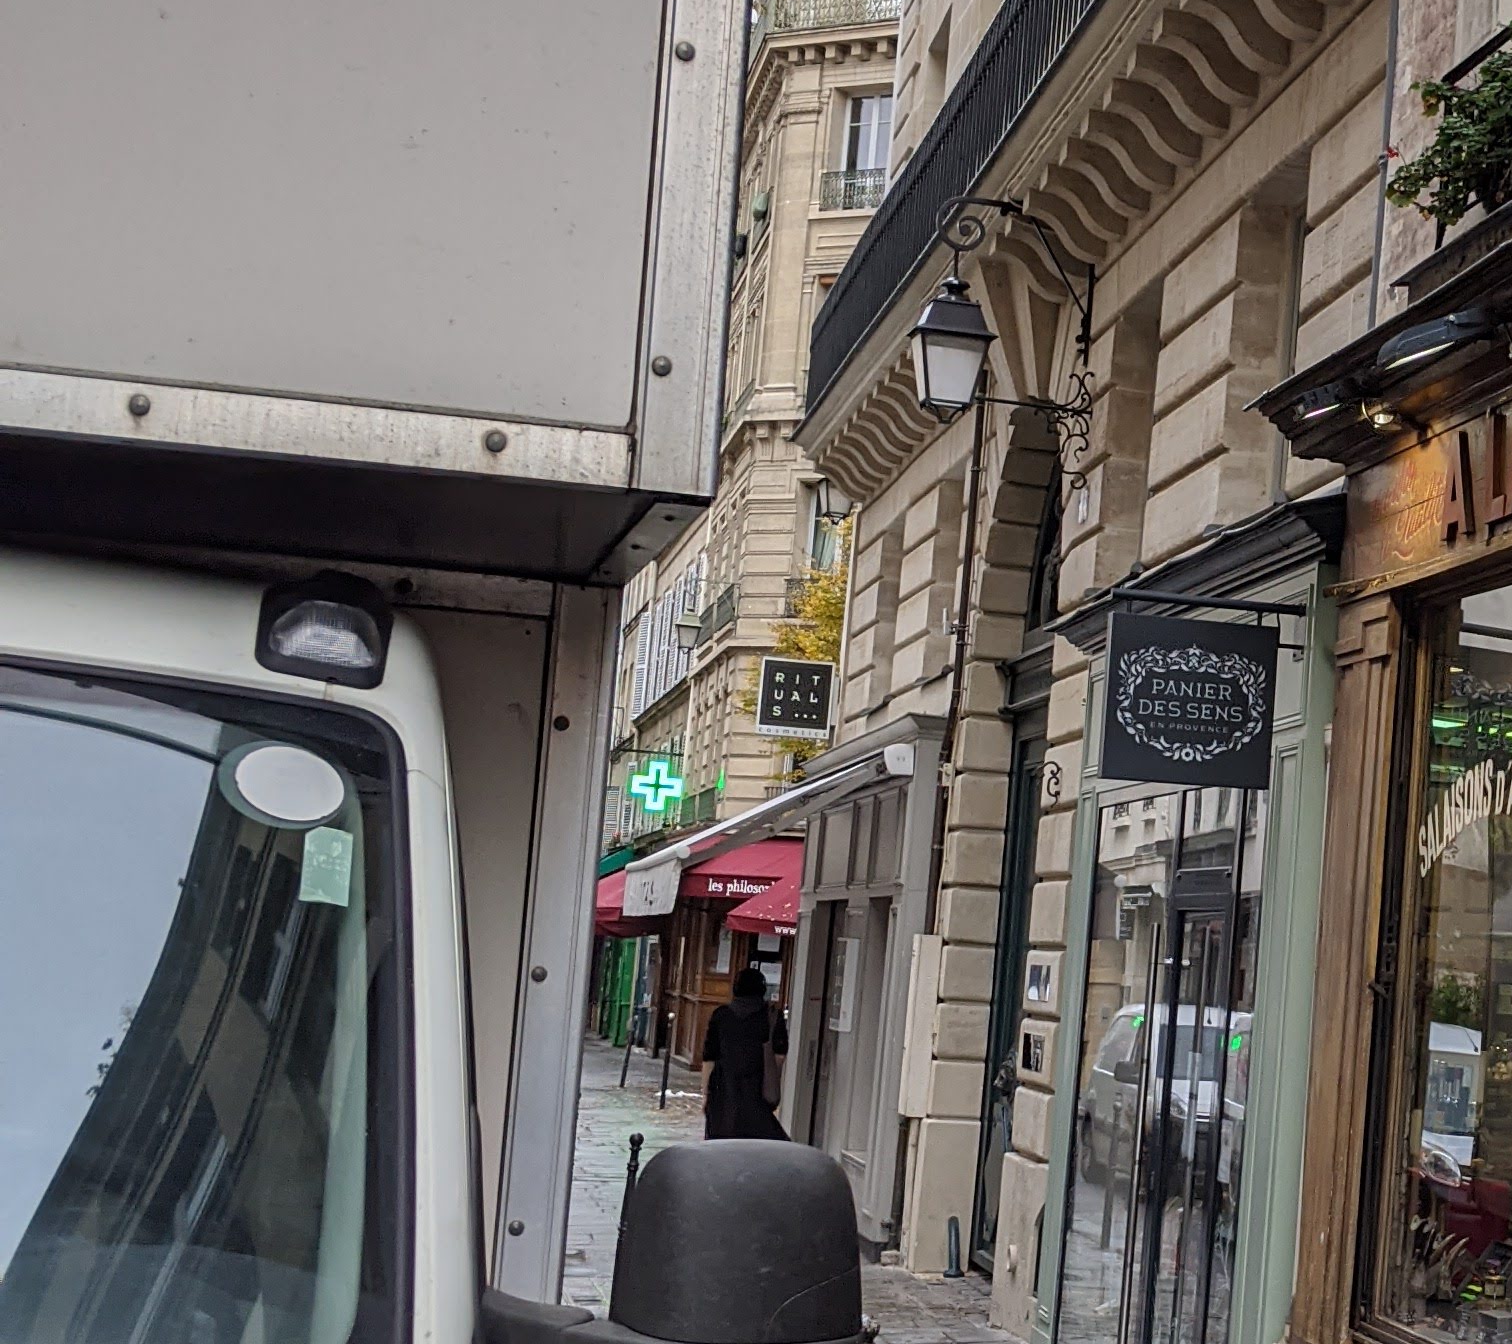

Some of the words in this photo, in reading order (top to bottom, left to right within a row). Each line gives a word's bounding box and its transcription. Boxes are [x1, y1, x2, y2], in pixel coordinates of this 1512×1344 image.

[1440, 430, 1475, 540] A
[1151, 678, 1232, 701] PANIER
[1138, 698, 1181, 718] DES
[1186, 702, 1243, 722] SENS
[1149, 721, 1165, 729] EN
[1169, 722, 1229, 734] PROVENCE
[1418, 758, 1494, 878] SALAISONS
[707, 878, 723, 892] les
